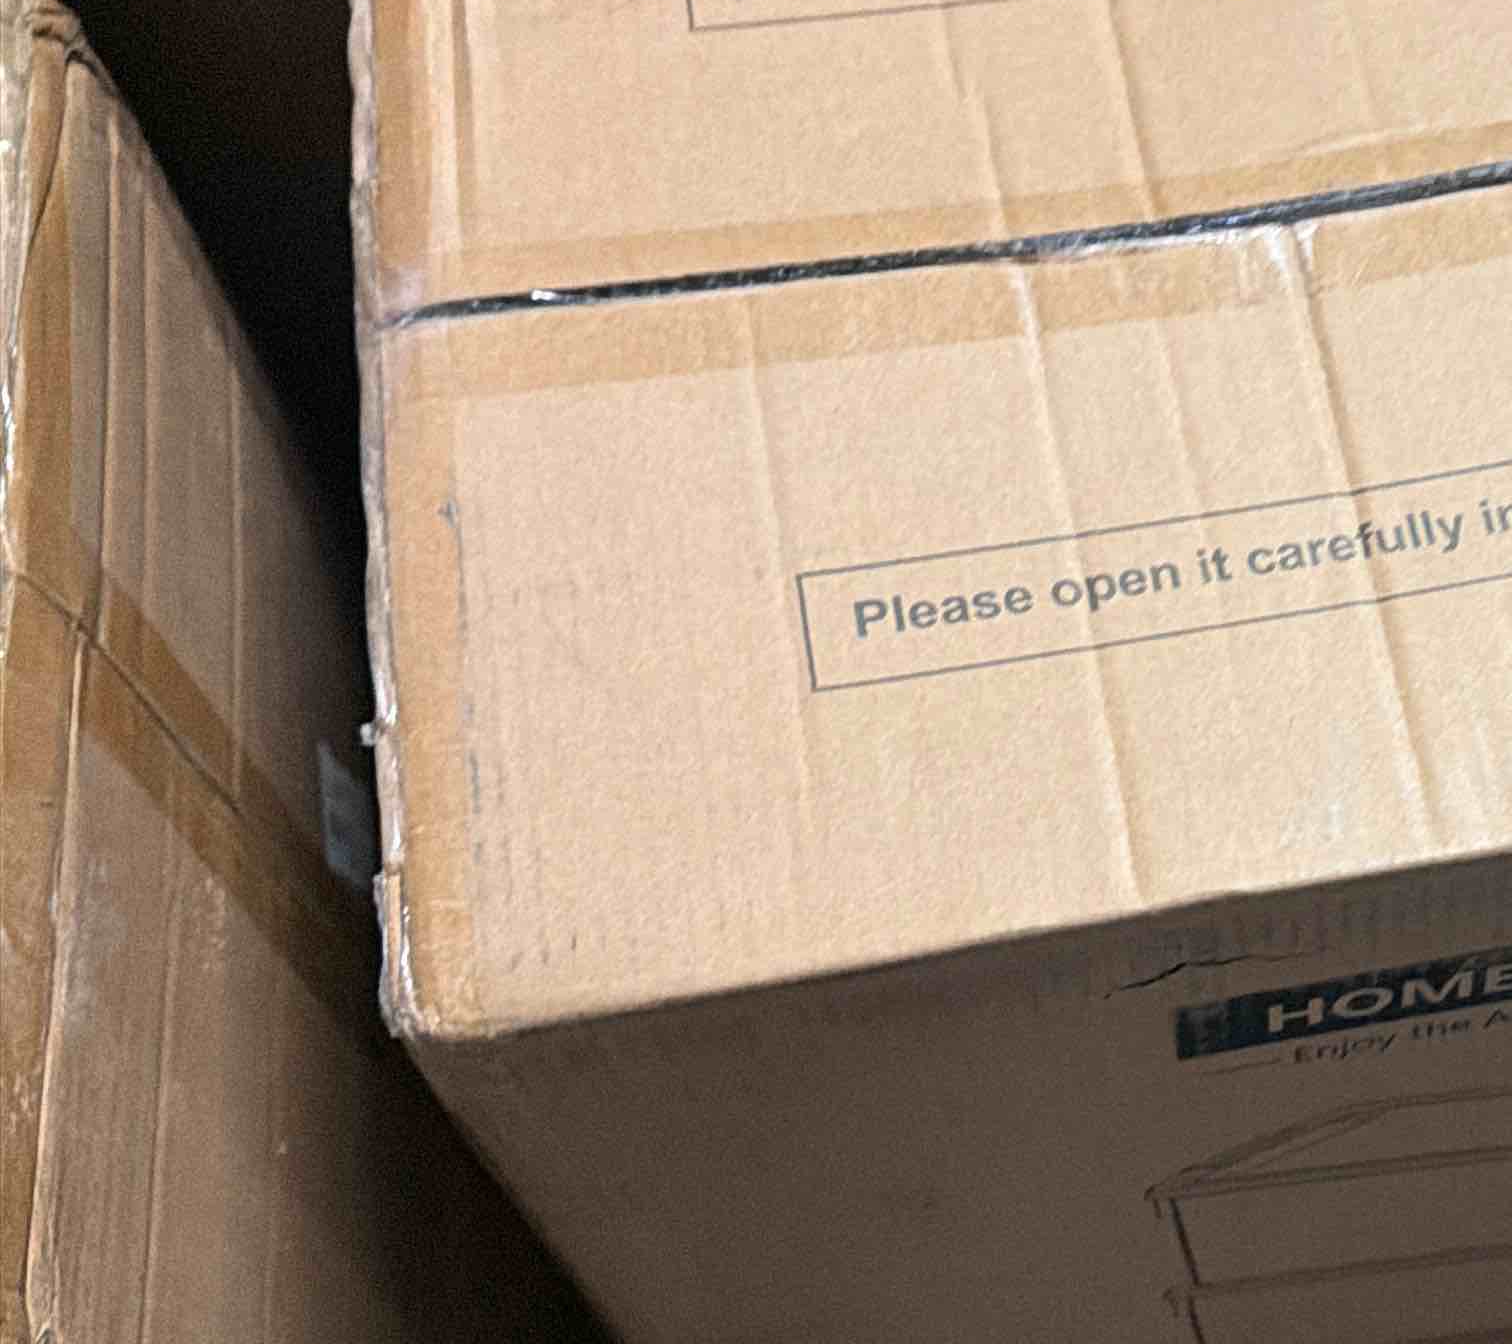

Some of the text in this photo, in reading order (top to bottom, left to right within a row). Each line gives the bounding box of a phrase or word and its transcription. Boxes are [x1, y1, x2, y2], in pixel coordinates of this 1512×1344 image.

[852, 580, 1033, 639] Please
[1051, 557, 1182, 612] open
[1196, 547, 1233, 585] it
[1248, 510, 1463, 575] carefully
[1294, 1032, 1397, 1064] Enjoy
[1411, 1018, 1471, 1040] the
